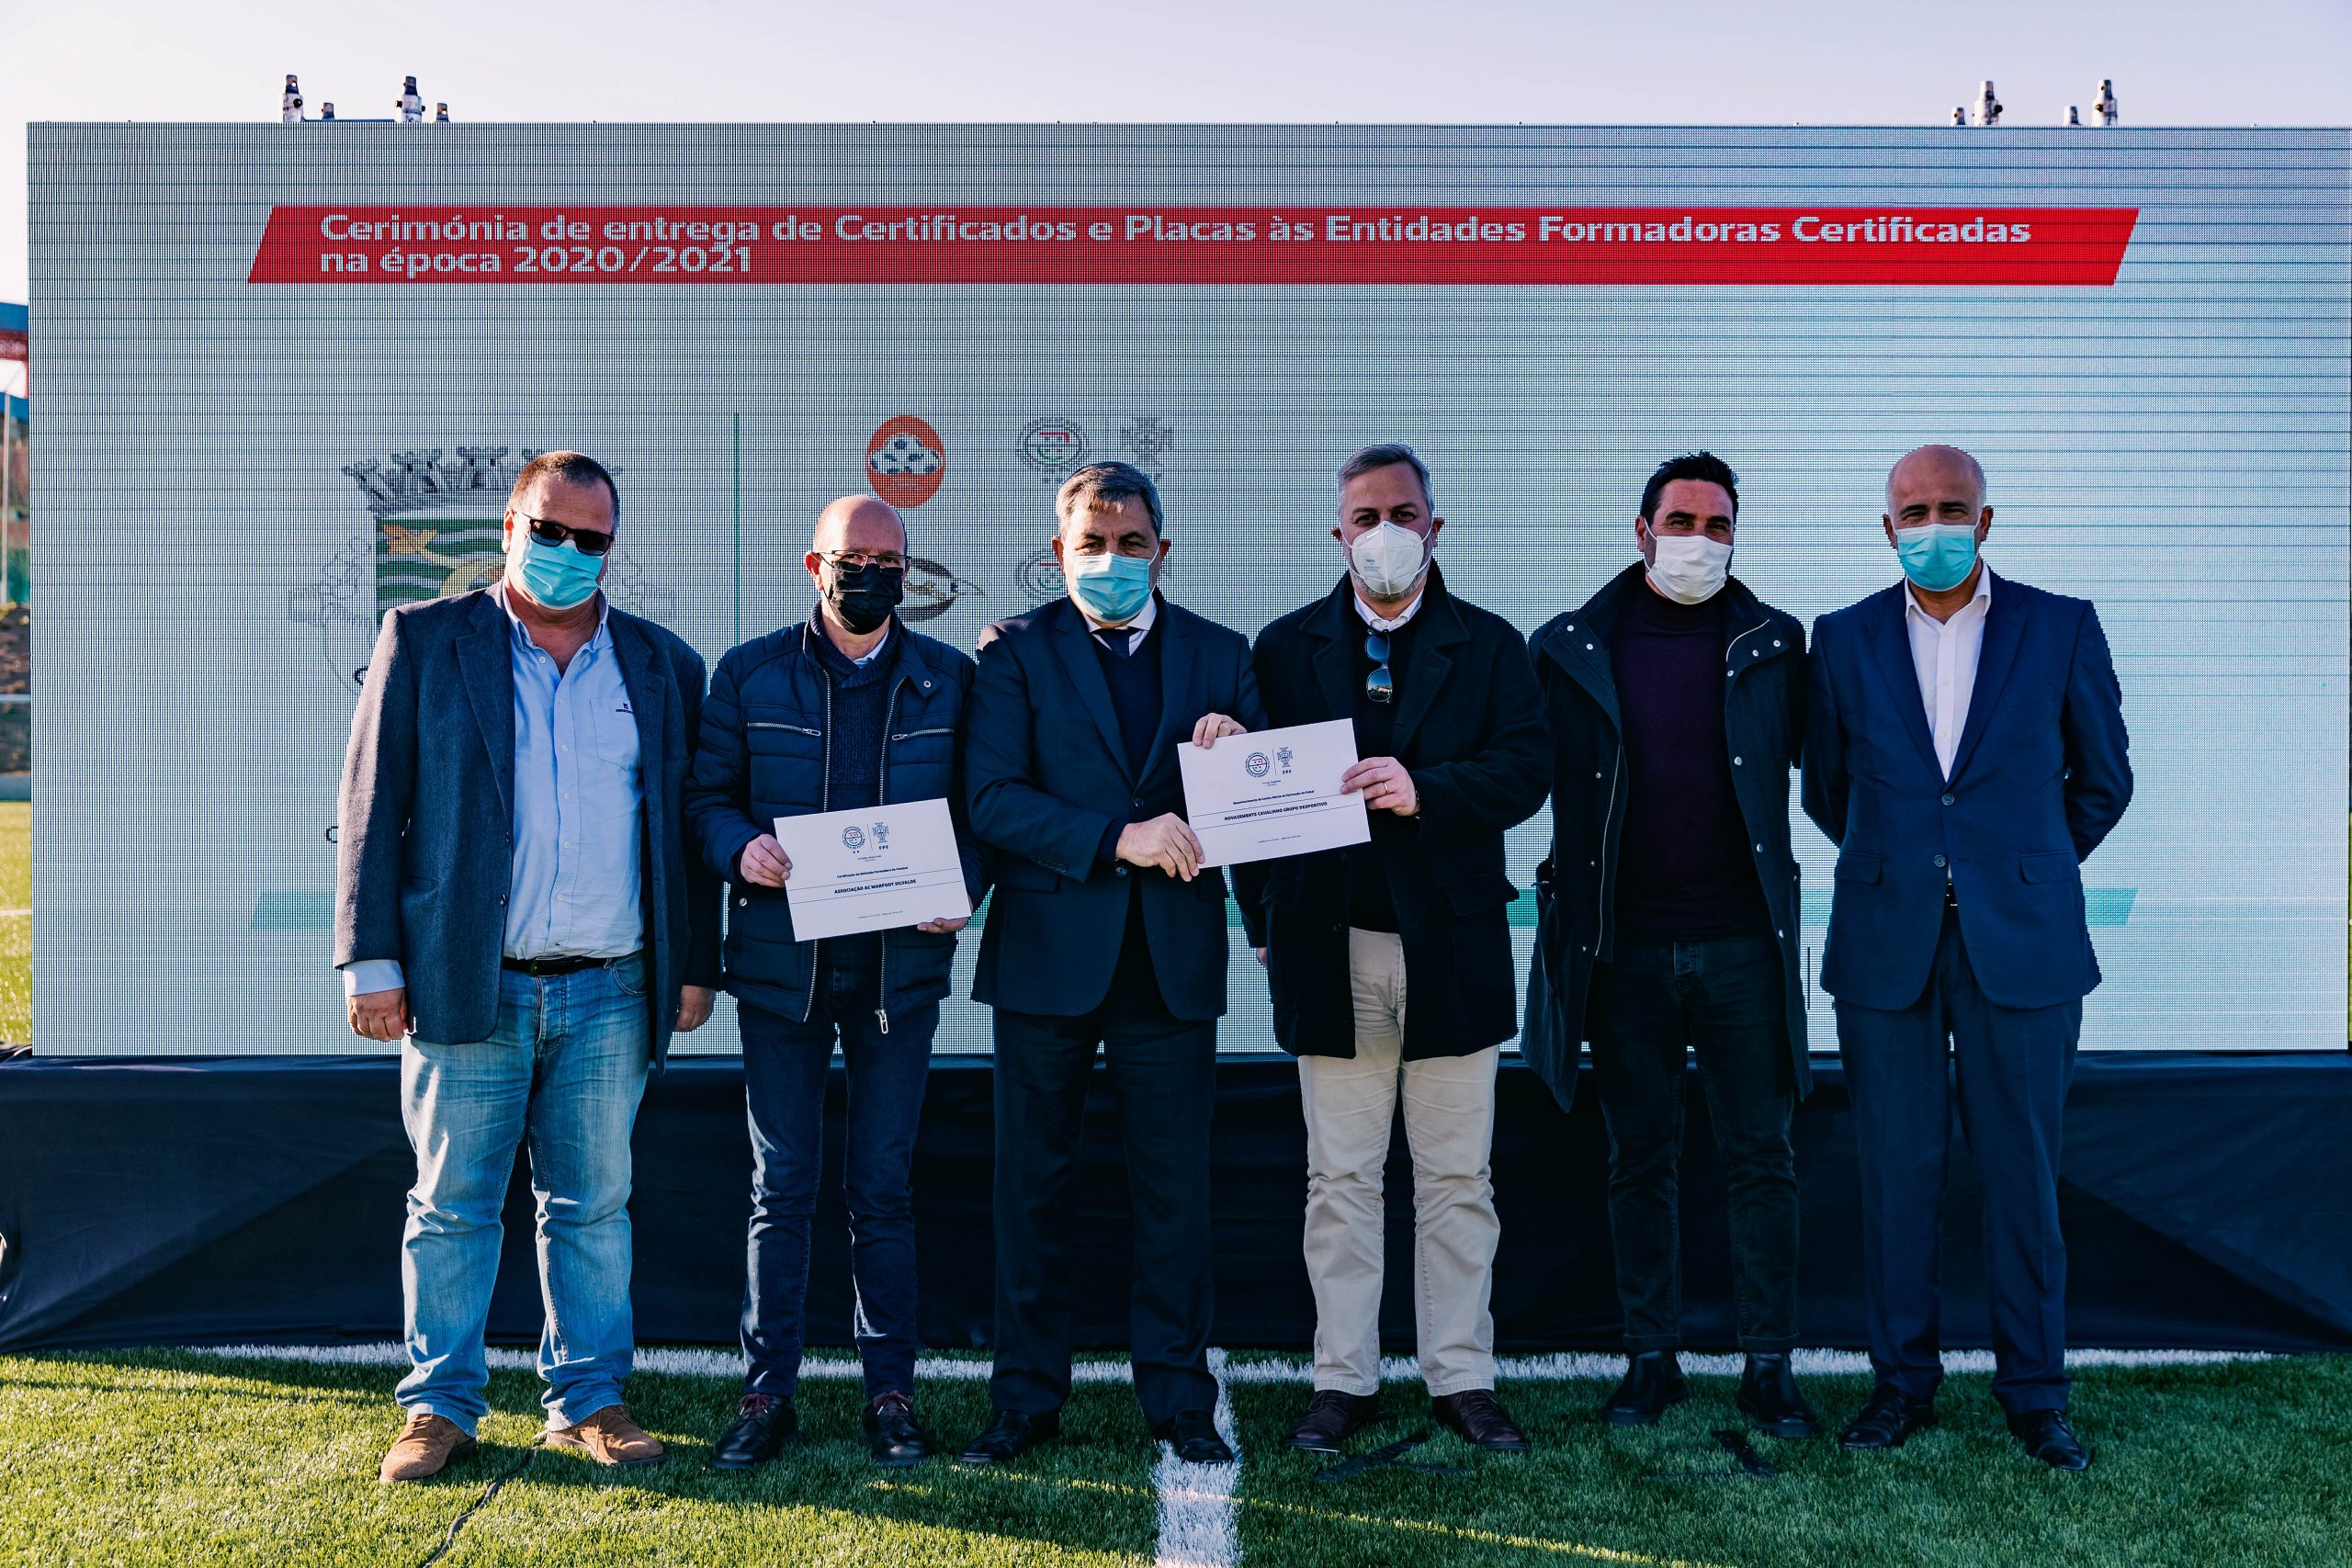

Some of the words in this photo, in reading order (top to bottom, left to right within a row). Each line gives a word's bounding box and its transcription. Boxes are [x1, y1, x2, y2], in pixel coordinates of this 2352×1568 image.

[320, 214, 527, 241] Cerimónia
[540, 214, 590, 241] de
[603, 216, 759, 248] entrega
[772, 214, 821, 241] de
[834, 214, 1077, 242] Certificados
[1088, 221, 1113, 242] e
[1125, 215, 1256, 242] Placas
[1269, 215, 1315, 242] às
[1326, 215, 1526, 242] Entidades
[1538, 215, 1781, 242] Formadoras
[1792, 216, 2031, 243] Certificadas
[321, 252, 368, 273] na
[379, 246, 501, 279] época
[514, 246, 750, 273] 2020/2021
[1224, 812, 1258, 821] NOVASEMENTE
[1299, 801, 1328, 810] DESPORTIVO
[834, 886, 864, 894] ASSOCIAÇÃO
